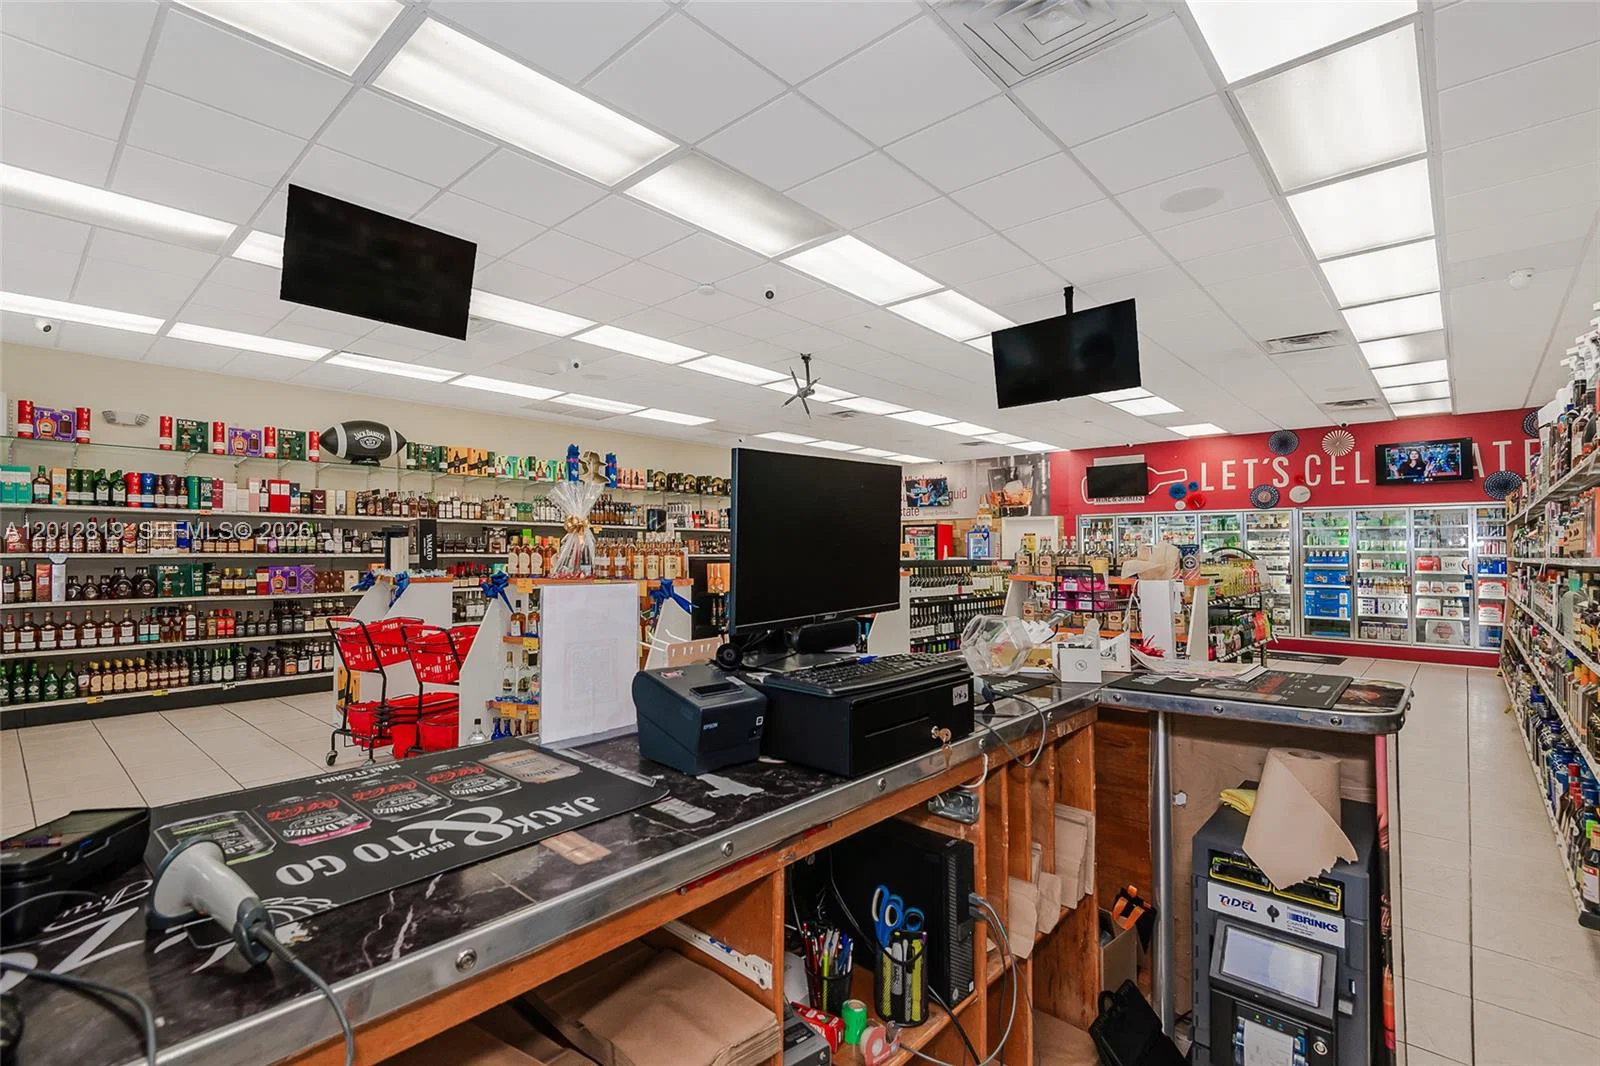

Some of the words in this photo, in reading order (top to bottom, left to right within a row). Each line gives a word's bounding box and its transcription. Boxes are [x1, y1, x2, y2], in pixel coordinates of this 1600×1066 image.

[1201, 456, 1289, 491] LET'S
[501, 796, 602, 835] JACK
[353, 832, 428, 863] TO
[408, 840, 455, 860] READY
[275, 855, 347, 886] GO
[1295, 914, 1339, 933] BRINKS
